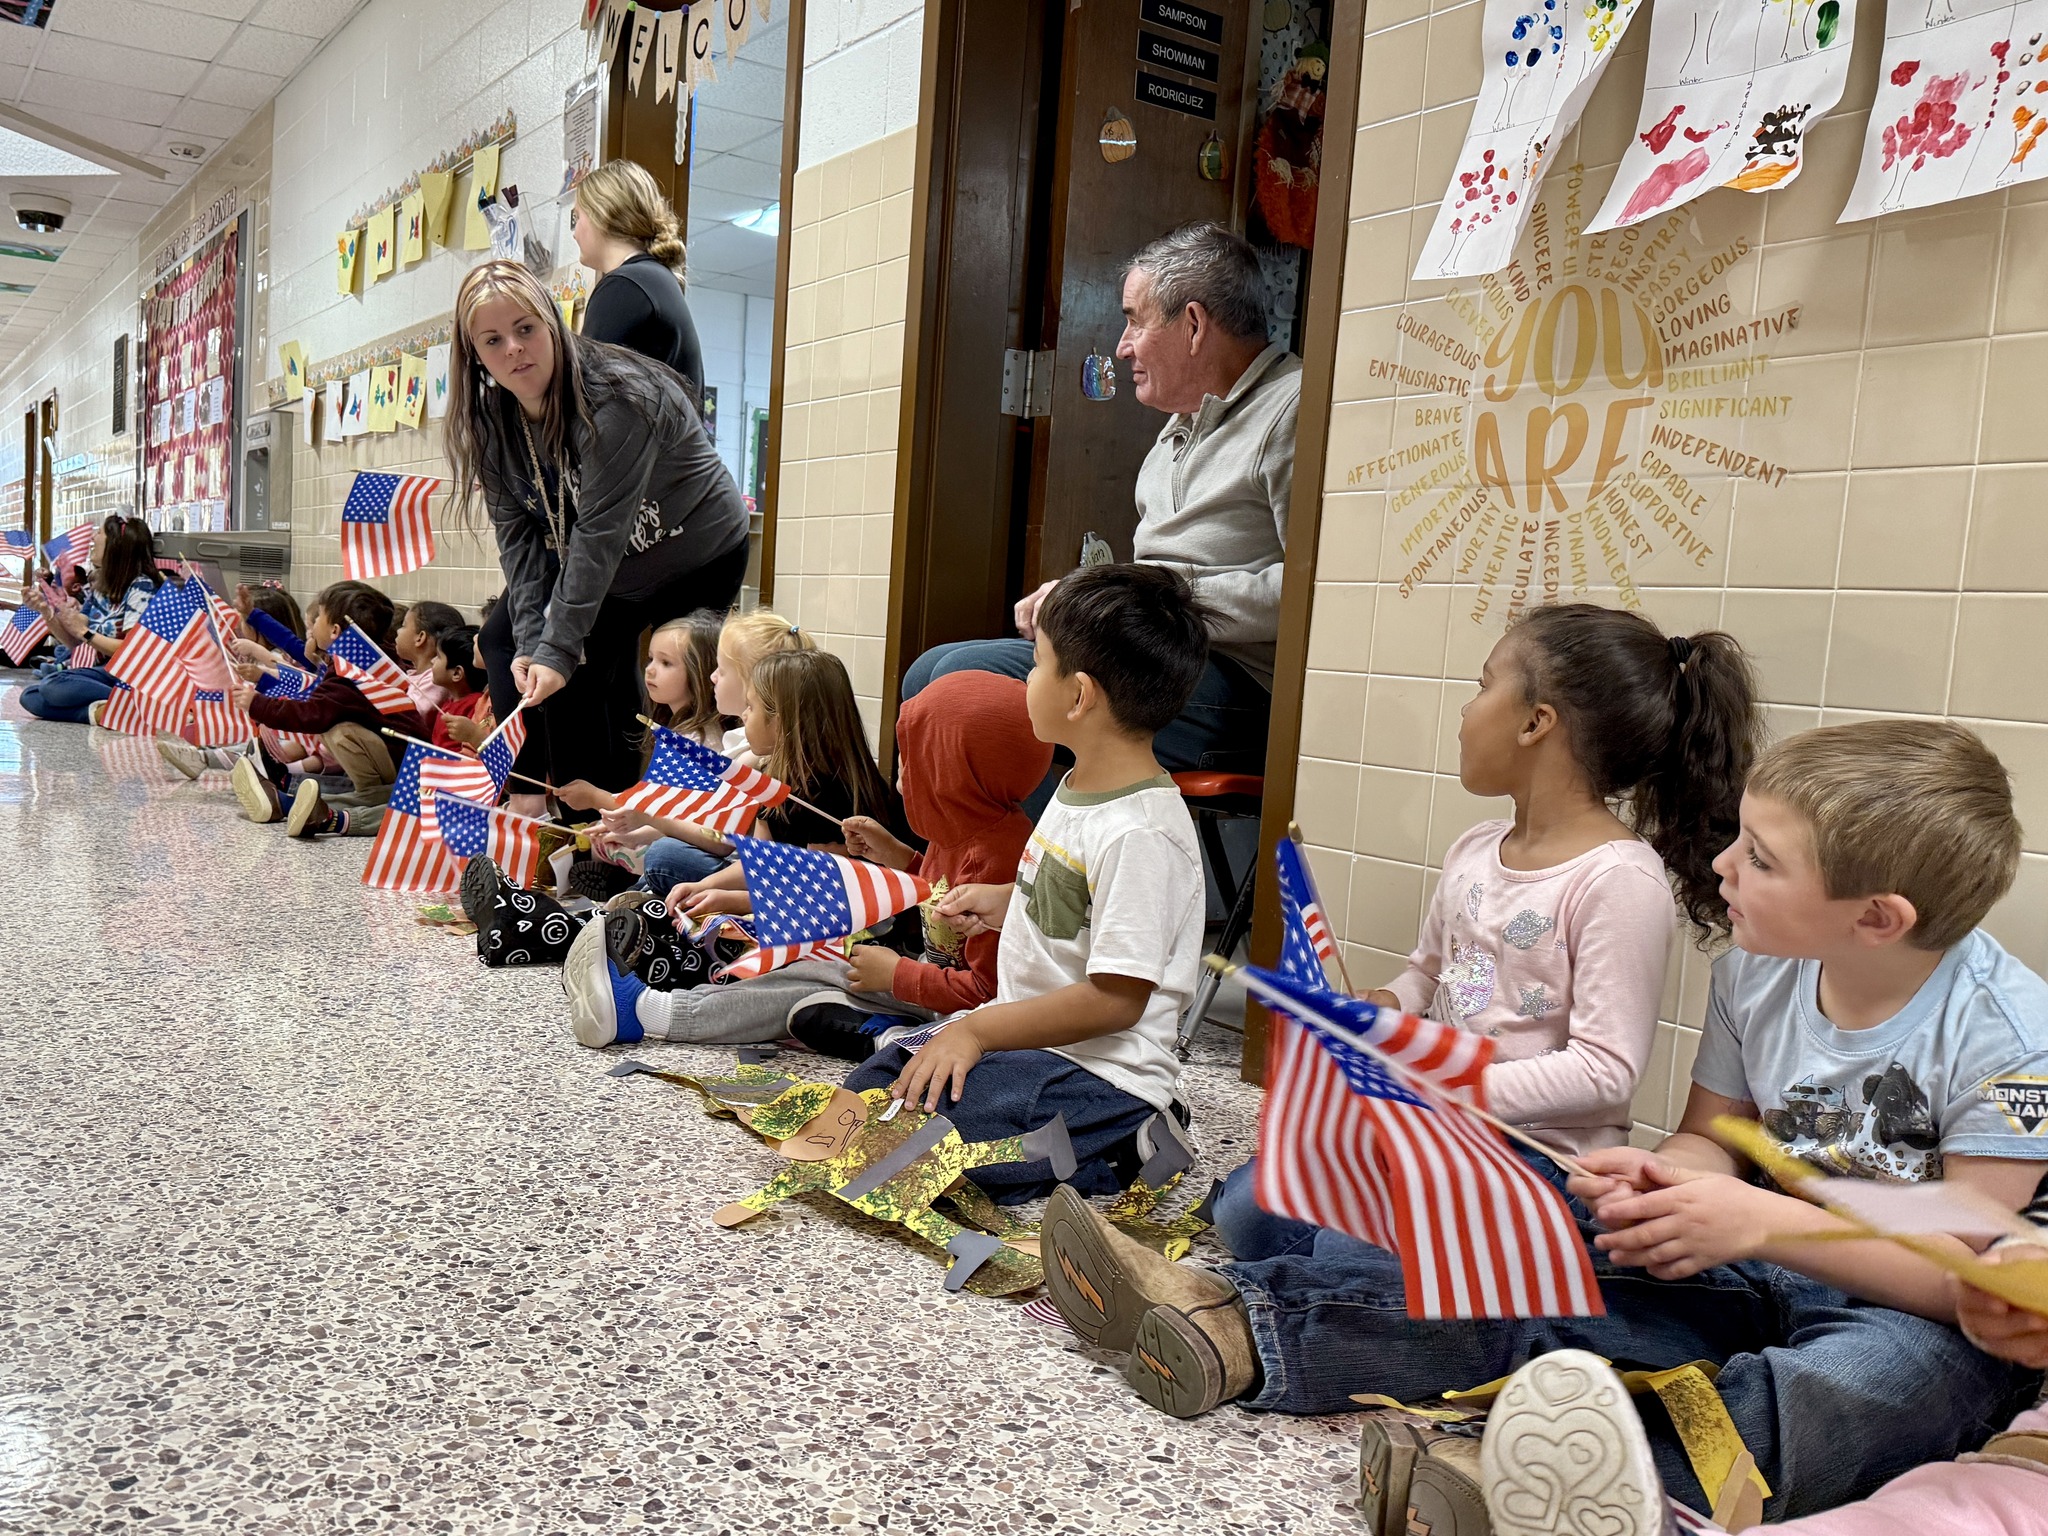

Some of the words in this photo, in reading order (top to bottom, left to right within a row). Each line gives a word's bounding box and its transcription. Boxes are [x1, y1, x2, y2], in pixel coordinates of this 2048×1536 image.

[1158, 4, 1207, 31] SAMPSON
[1152, 43, 1205, 71] SHOWMAN
[1148, 83, 1204, 110] RODRIGUEZ
[1532, 201, 1553, 291] SINCERE
[1621, 199, 1698, 294] INSPIRAT
[1638, 246, 1692, 309] SASSY
[1506, 259, 1531, 303] KIND
[1653, 235, 1750, 324] GORGEOUS
[1396, 312, 1481, 371] COURAGEOUS
[1446, 286, 1496, 346] CLEVER
[1484, 285, 1665, 403] YOU
[1658, 293, 1731, 344] LOVING
[1664, 308, 1800, 368] IMAGINATIVE
[1369, 359, 1472, 398] ENTHUSIASTIC
[1668, 353, 1770, 393] BRILLIANT
[1415, 405, 1464, 427] BRAVE
[1660, 396, 1793, 420] SIGNIFICANT
[1347, 428, 1463, 486] AFFECTIONATE
[1391, 449, 1468, 514] GENEROUS
[1640, 450, 1708, 517] CAPABLE
[1650, 424, 1788, 488] INDEPENDENT
[1399, 487, 1489, 600] SPONTANEOUS
[1400, 468, 1475, 558] IMPORTANT
[1456, 501, 1502, 576] WORTHY
[1603, 486, 1653, 560] HONEST
[1621, 471, 1714, 568] SUPPORTIVE
[1470, 513, 1520, 625] AUTHENTIC
[1567, 511, 1588, 597] DYNAMIC
